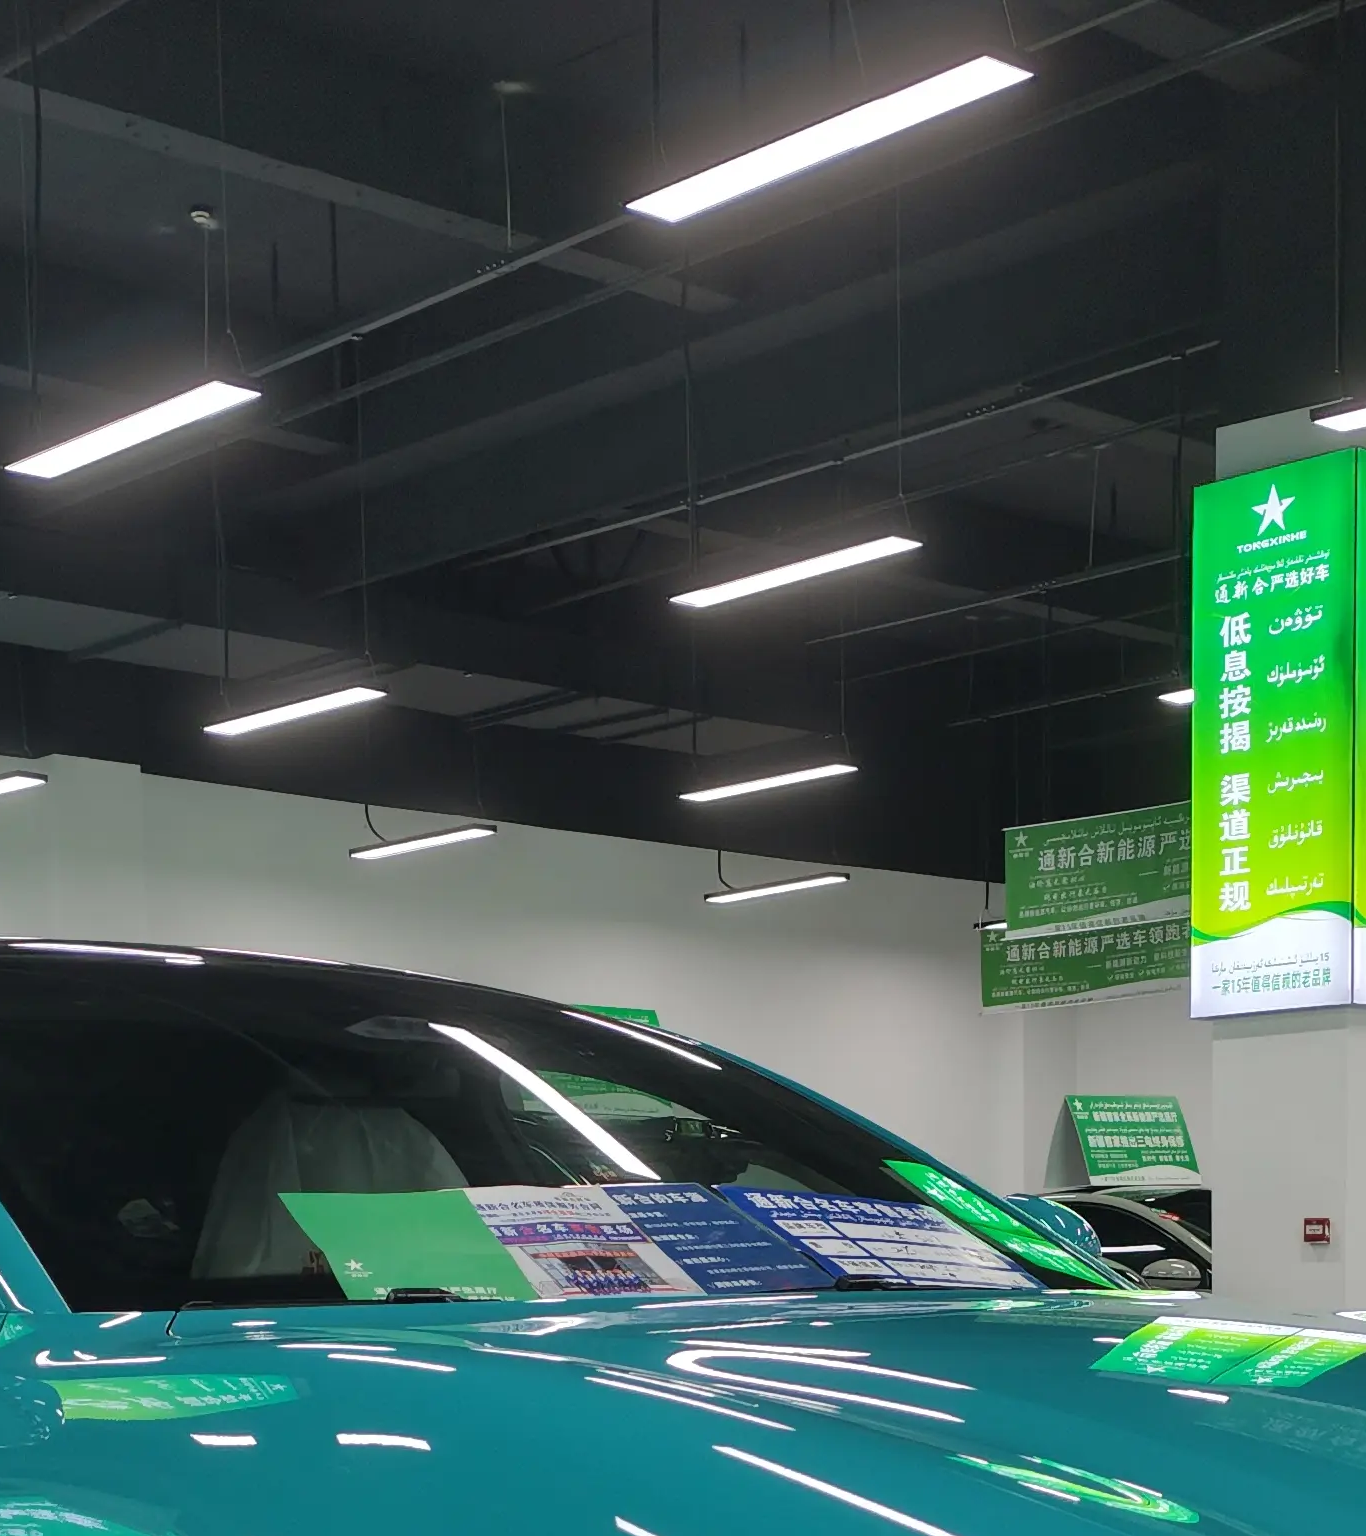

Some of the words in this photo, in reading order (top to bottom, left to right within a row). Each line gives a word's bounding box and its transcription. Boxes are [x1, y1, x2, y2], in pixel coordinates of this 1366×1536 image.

[1215, 564, 1329, 603] 通新合严选好车
[1237, 530, 1307, 553] TONGXINHE
[1219, 612, 1252, 754] 低息按揭
[1219, 772, 1252, 912] 渠道正规
